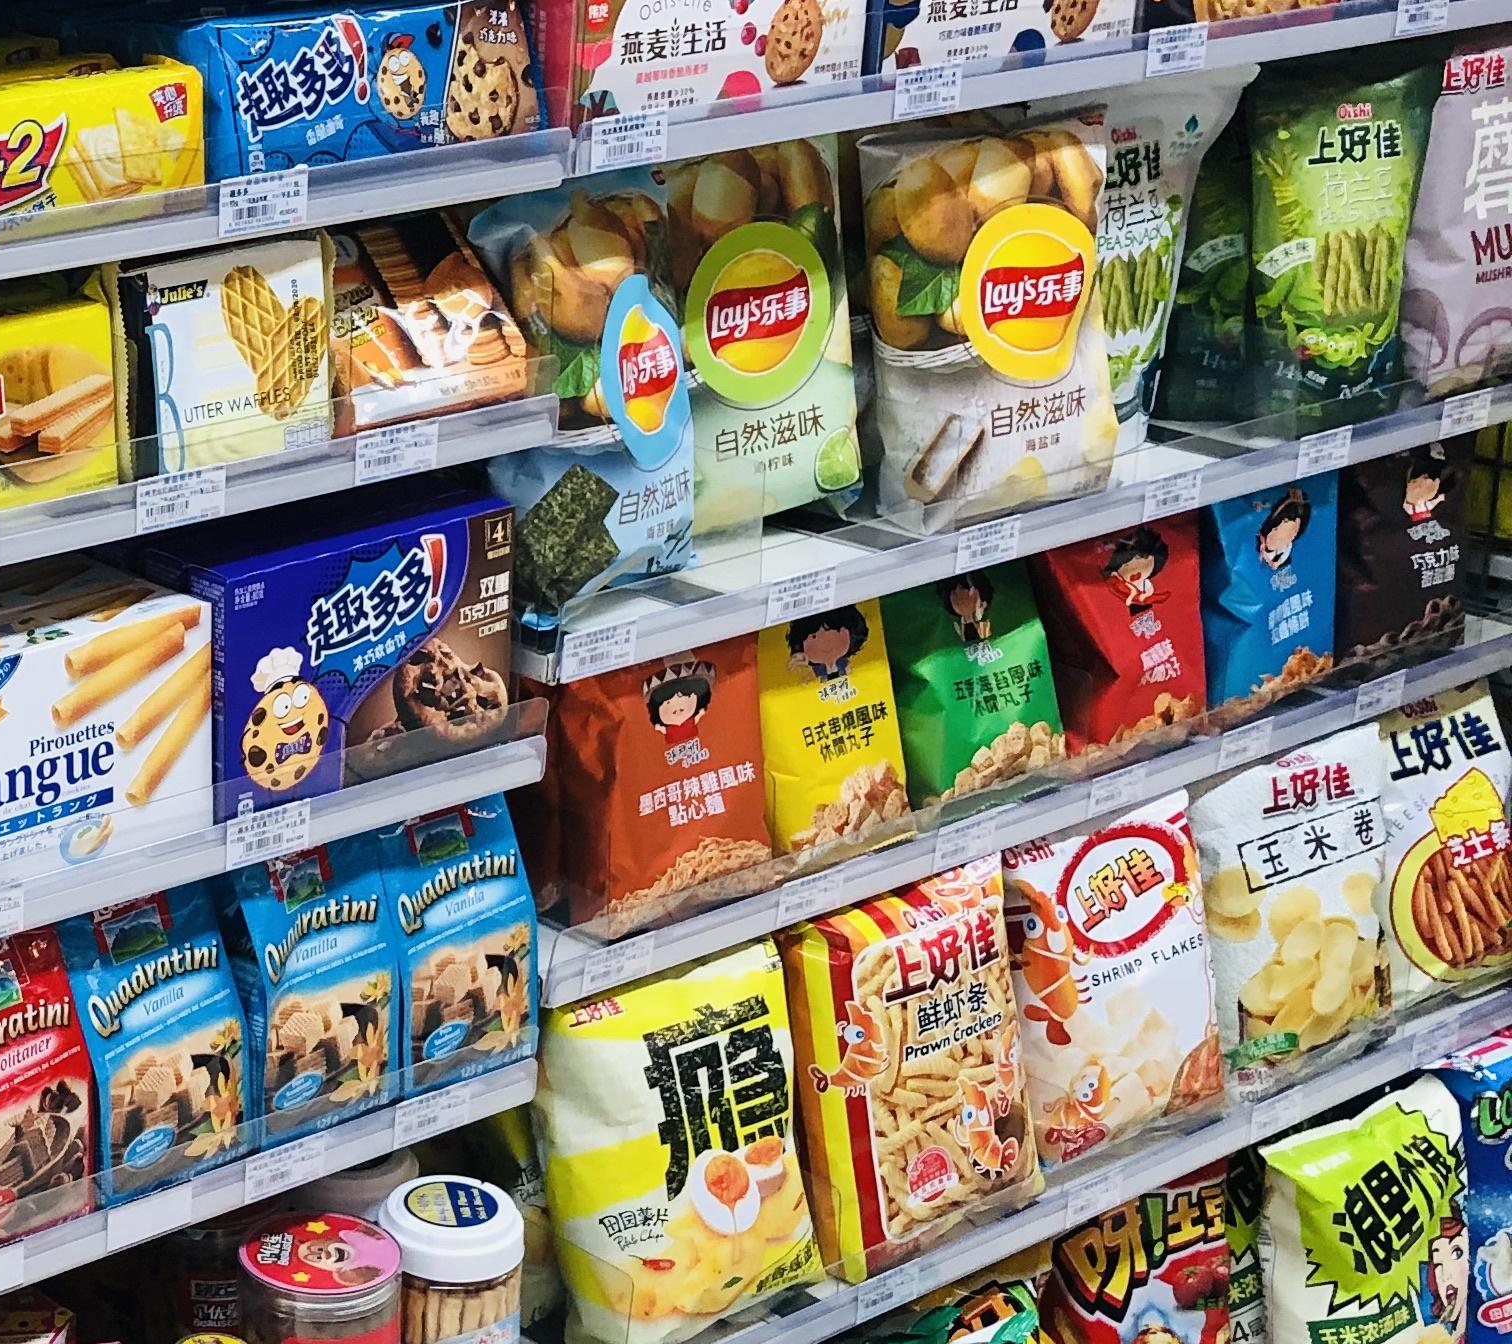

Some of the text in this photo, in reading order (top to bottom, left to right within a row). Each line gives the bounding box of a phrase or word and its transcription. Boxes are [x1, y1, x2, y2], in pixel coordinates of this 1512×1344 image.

[478, 25, 518, 43] 巧克力味
[620, 17, 729, 67] 燕麦生活
[1338, 103, 1373, 120] Oishi
[1308, 124, 1401, 167] 上好佳
[160, 282, 207, 306] Julie's
[714, 403, 826, 458] 自然滋味
[990, 386, 1086, 438] 自然滋味
[618, 467, 691, 525] 自然滋味
[458, 597, 509, 626] 巧克力味
[28, 721, 116, 757] Pirouettes
[1389, 711, 1503, 784] 上好佳
[1261, 762, 1357, 817] 上好佳
[1257, 808, 1376, 882] 玉米卷
[1072, 848, 1165, 934] 上好佳
[884, 911, 1002, 1006] 上好佳
[1090, 933, 1205, 989] SHRIMP FLAKES
[141, 984, 185, 1019] Vanilla
[916, 981, 989, 1037] 鲜虾条
[904, 1010, 1004, 1064] Prawn Crackers
